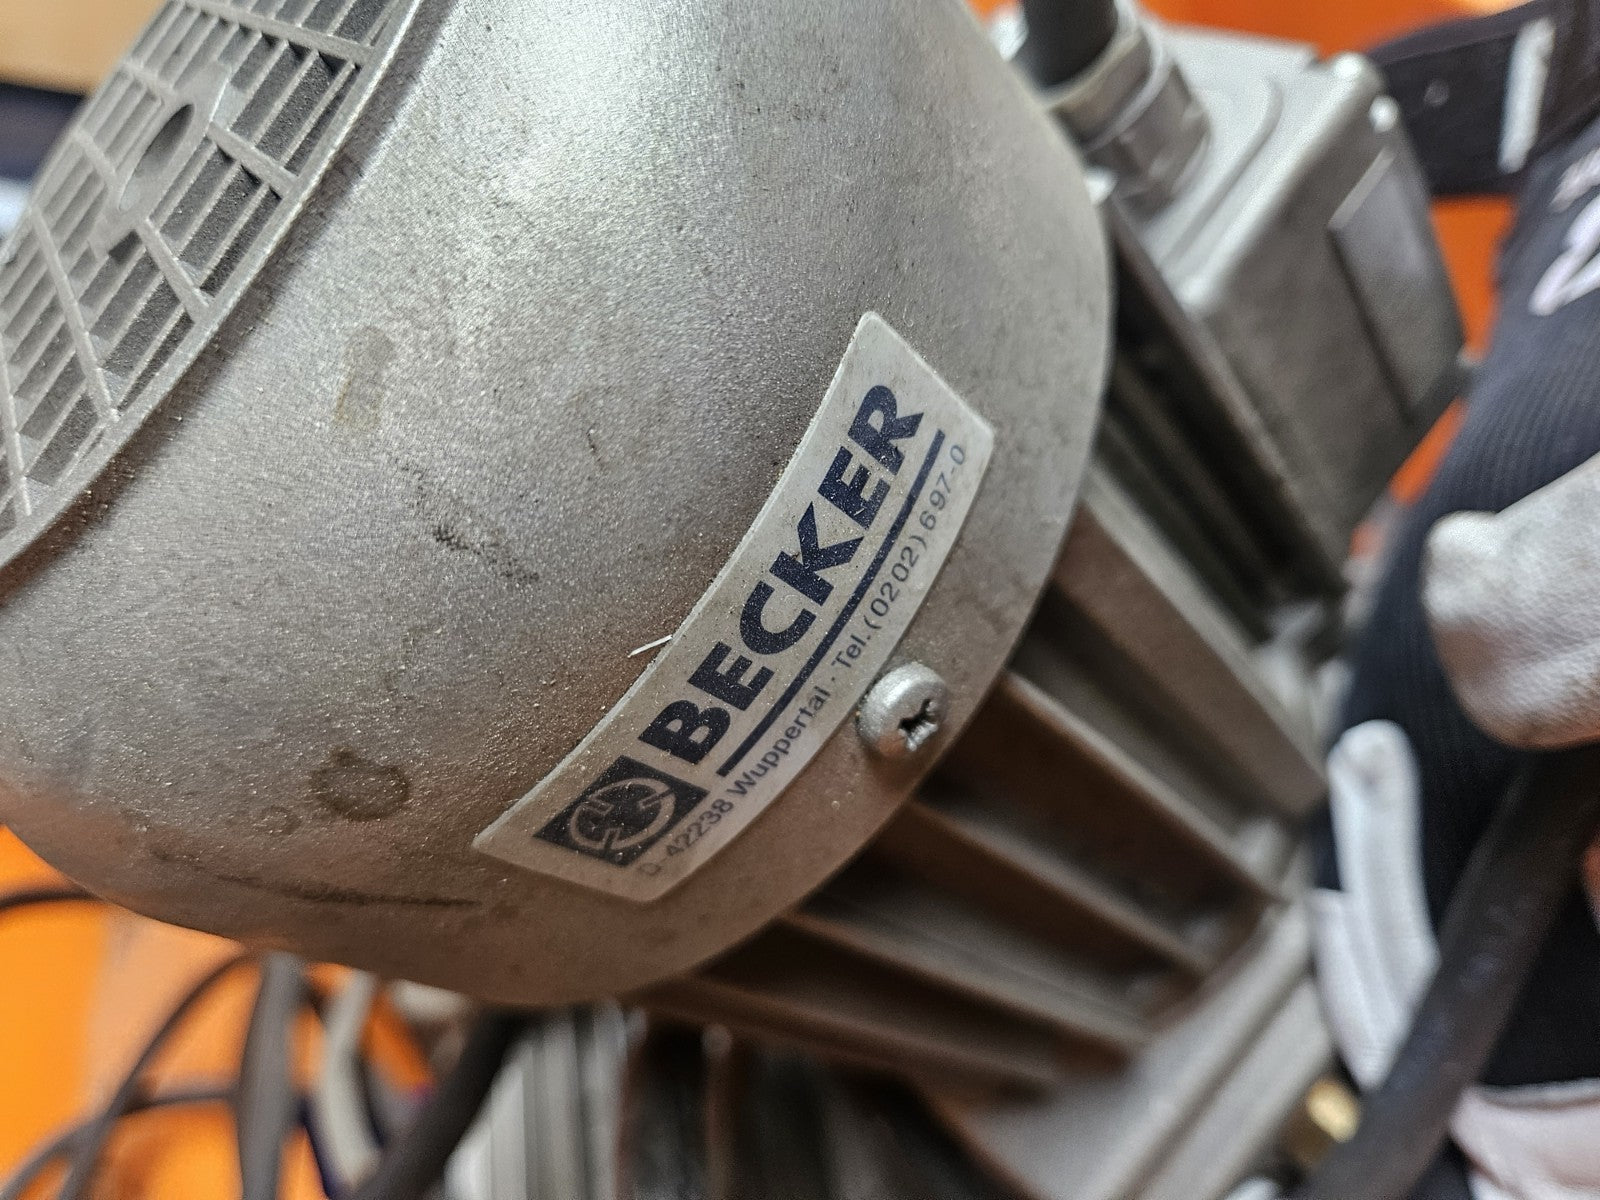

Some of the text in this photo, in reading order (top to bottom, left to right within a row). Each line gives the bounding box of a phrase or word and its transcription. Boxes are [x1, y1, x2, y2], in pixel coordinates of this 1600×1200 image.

[636, 798, 733, 876] D-42238
[727, 685, 831, 796] Wuppertal
[919, 444, 966, 532] 697-0
[638, 385, 923, 764] BECKER
